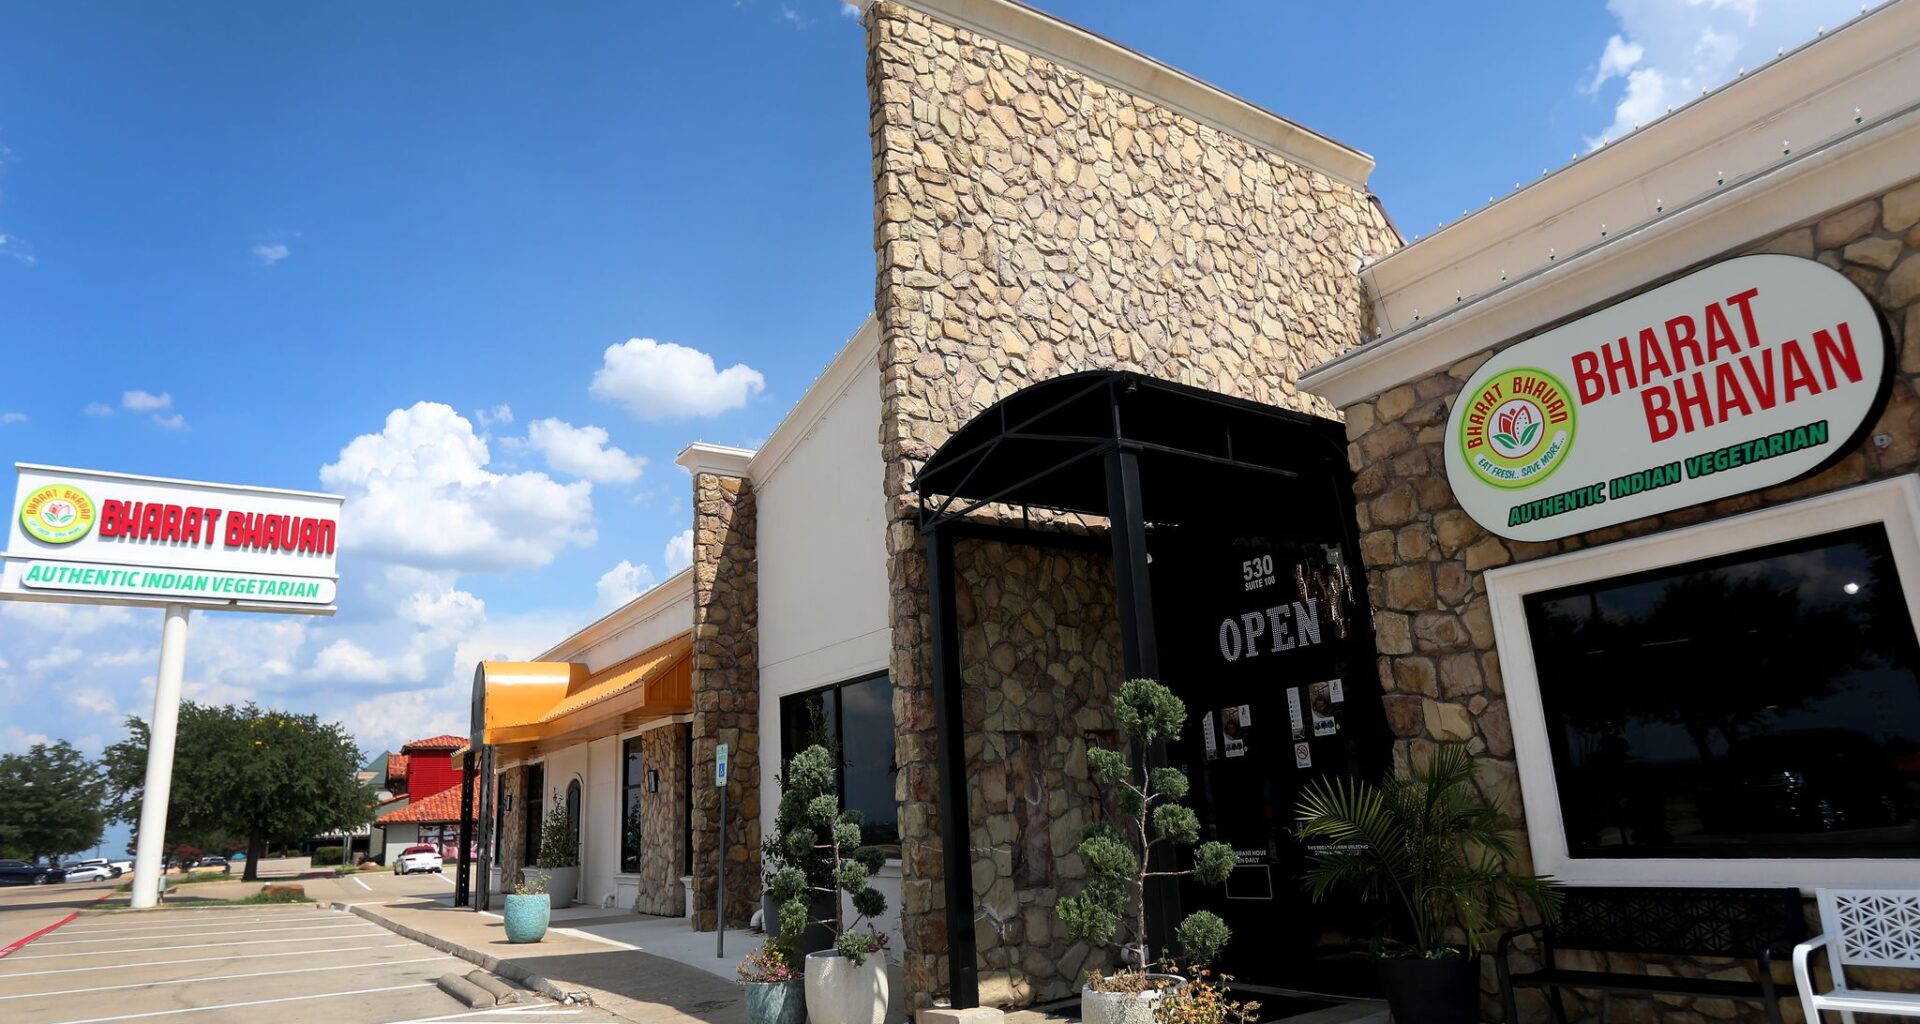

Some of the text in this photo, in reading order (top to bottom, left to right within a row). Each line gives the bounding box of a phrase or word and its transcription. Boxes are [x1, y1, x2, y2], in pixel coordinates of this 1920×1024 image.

[1571, 287, 1761, 406] BHARAT
[1640, 321, 1864, 444] BHAVAN
[1467, 383, 1503, 449] BHARAT
[1478, 458, 1493, 472] EAT
[1521, 461, 1542, 477] SAVE
[1508, 420, 1829, 527] AUTHENTIC INDIAN VEGETARIAN
[99, 499, 337, 554] BHARAT BHAVAN
[26, 564, 320, 598] AUTHENTIC INDIAN VEGETARIAN
[1243, 554, 1273, 581] 530
[1245, 575, 1276, 592] SUITE 100
[1219, 597, 1322, 662] OPEN
